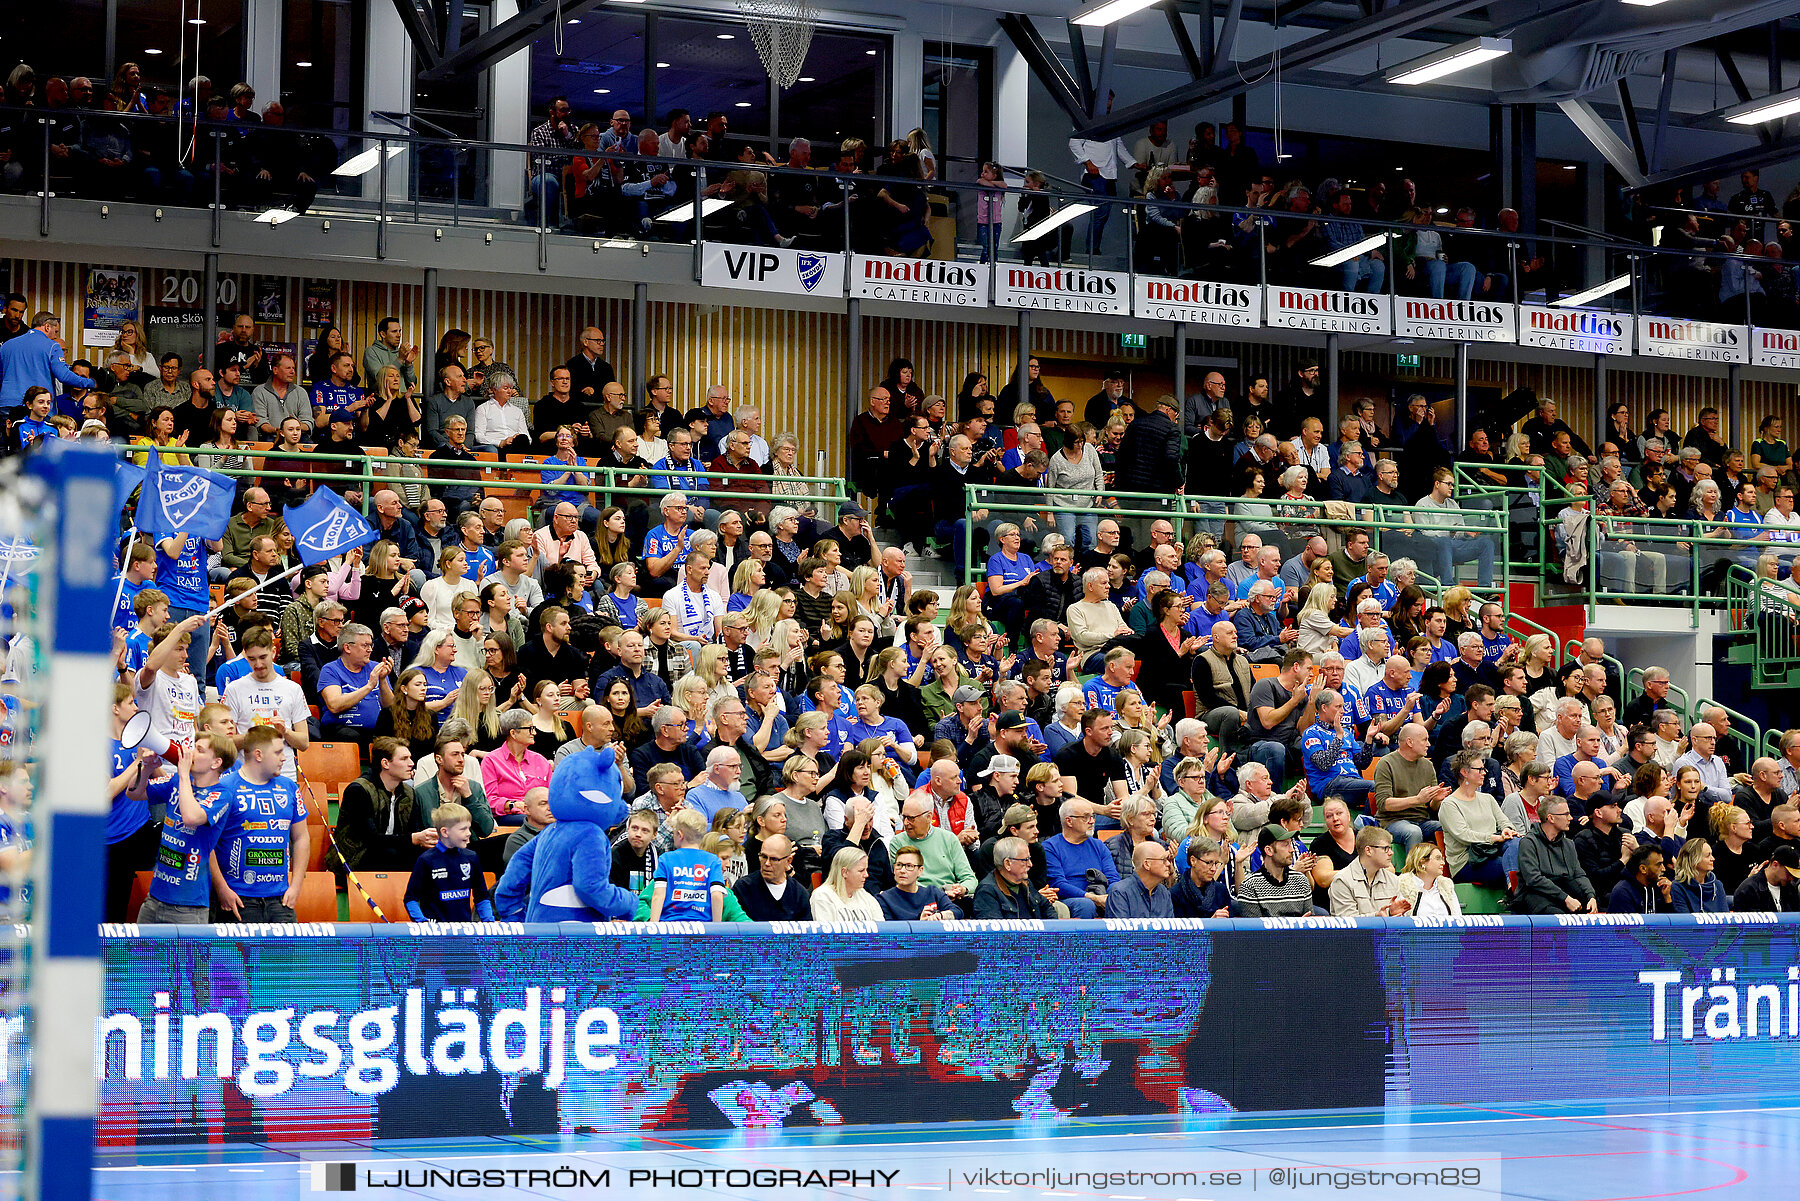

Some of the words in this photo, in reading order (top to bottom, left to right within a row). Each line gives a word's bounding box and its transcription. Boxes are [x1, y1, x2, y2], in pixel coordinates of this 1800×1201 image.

[724, 250, 780, 282] VIP
[864, 260, 977, 287] mattias
[161, 276, 237, 305] 200
[1008, 269, 1117, 295] mattias
[873, 287, 967, 305] CATERING
[1148, 281, 1250, 307] mattias
[1018, 296, 1108, 313] CATERING
[1279, 291, 1379, 316] mattias
[1406, 301, 1504, 324] mattias
[150, 314, 180, 324] Arena
[1156, 307, 1241, 325] CATERING
[1288, 317, 1371, 333] CATERING
[1531, 311, 1622, 337] mattias
[1415, 326, 1496, 341] CATERING
[1649, 322, 1738, 345] mattias
[1538, 336, 1614, 353] CATERING
[1657, 346, 1731, 362] CATERING
[164, 477, 204, 503] SKÖVDE
[120, 600, 131, 610] 87
[248, 695, 260, 705] 14
[1102, 694, 1112, 706] 21
[236, 794, 256, 812] 37
[161, 832, 186, 848] VOLVO
[247, 836, 285, 844] VOLVO
[248, 850, 283, 858] GRÖNSAKS
[186, 848, 201, 881] DALOC
[256, 873, 285, 883] SKÖVDE
[440, 889, 470, 900] BRANDT
[1638, 966, 1800, 1041] Träni
